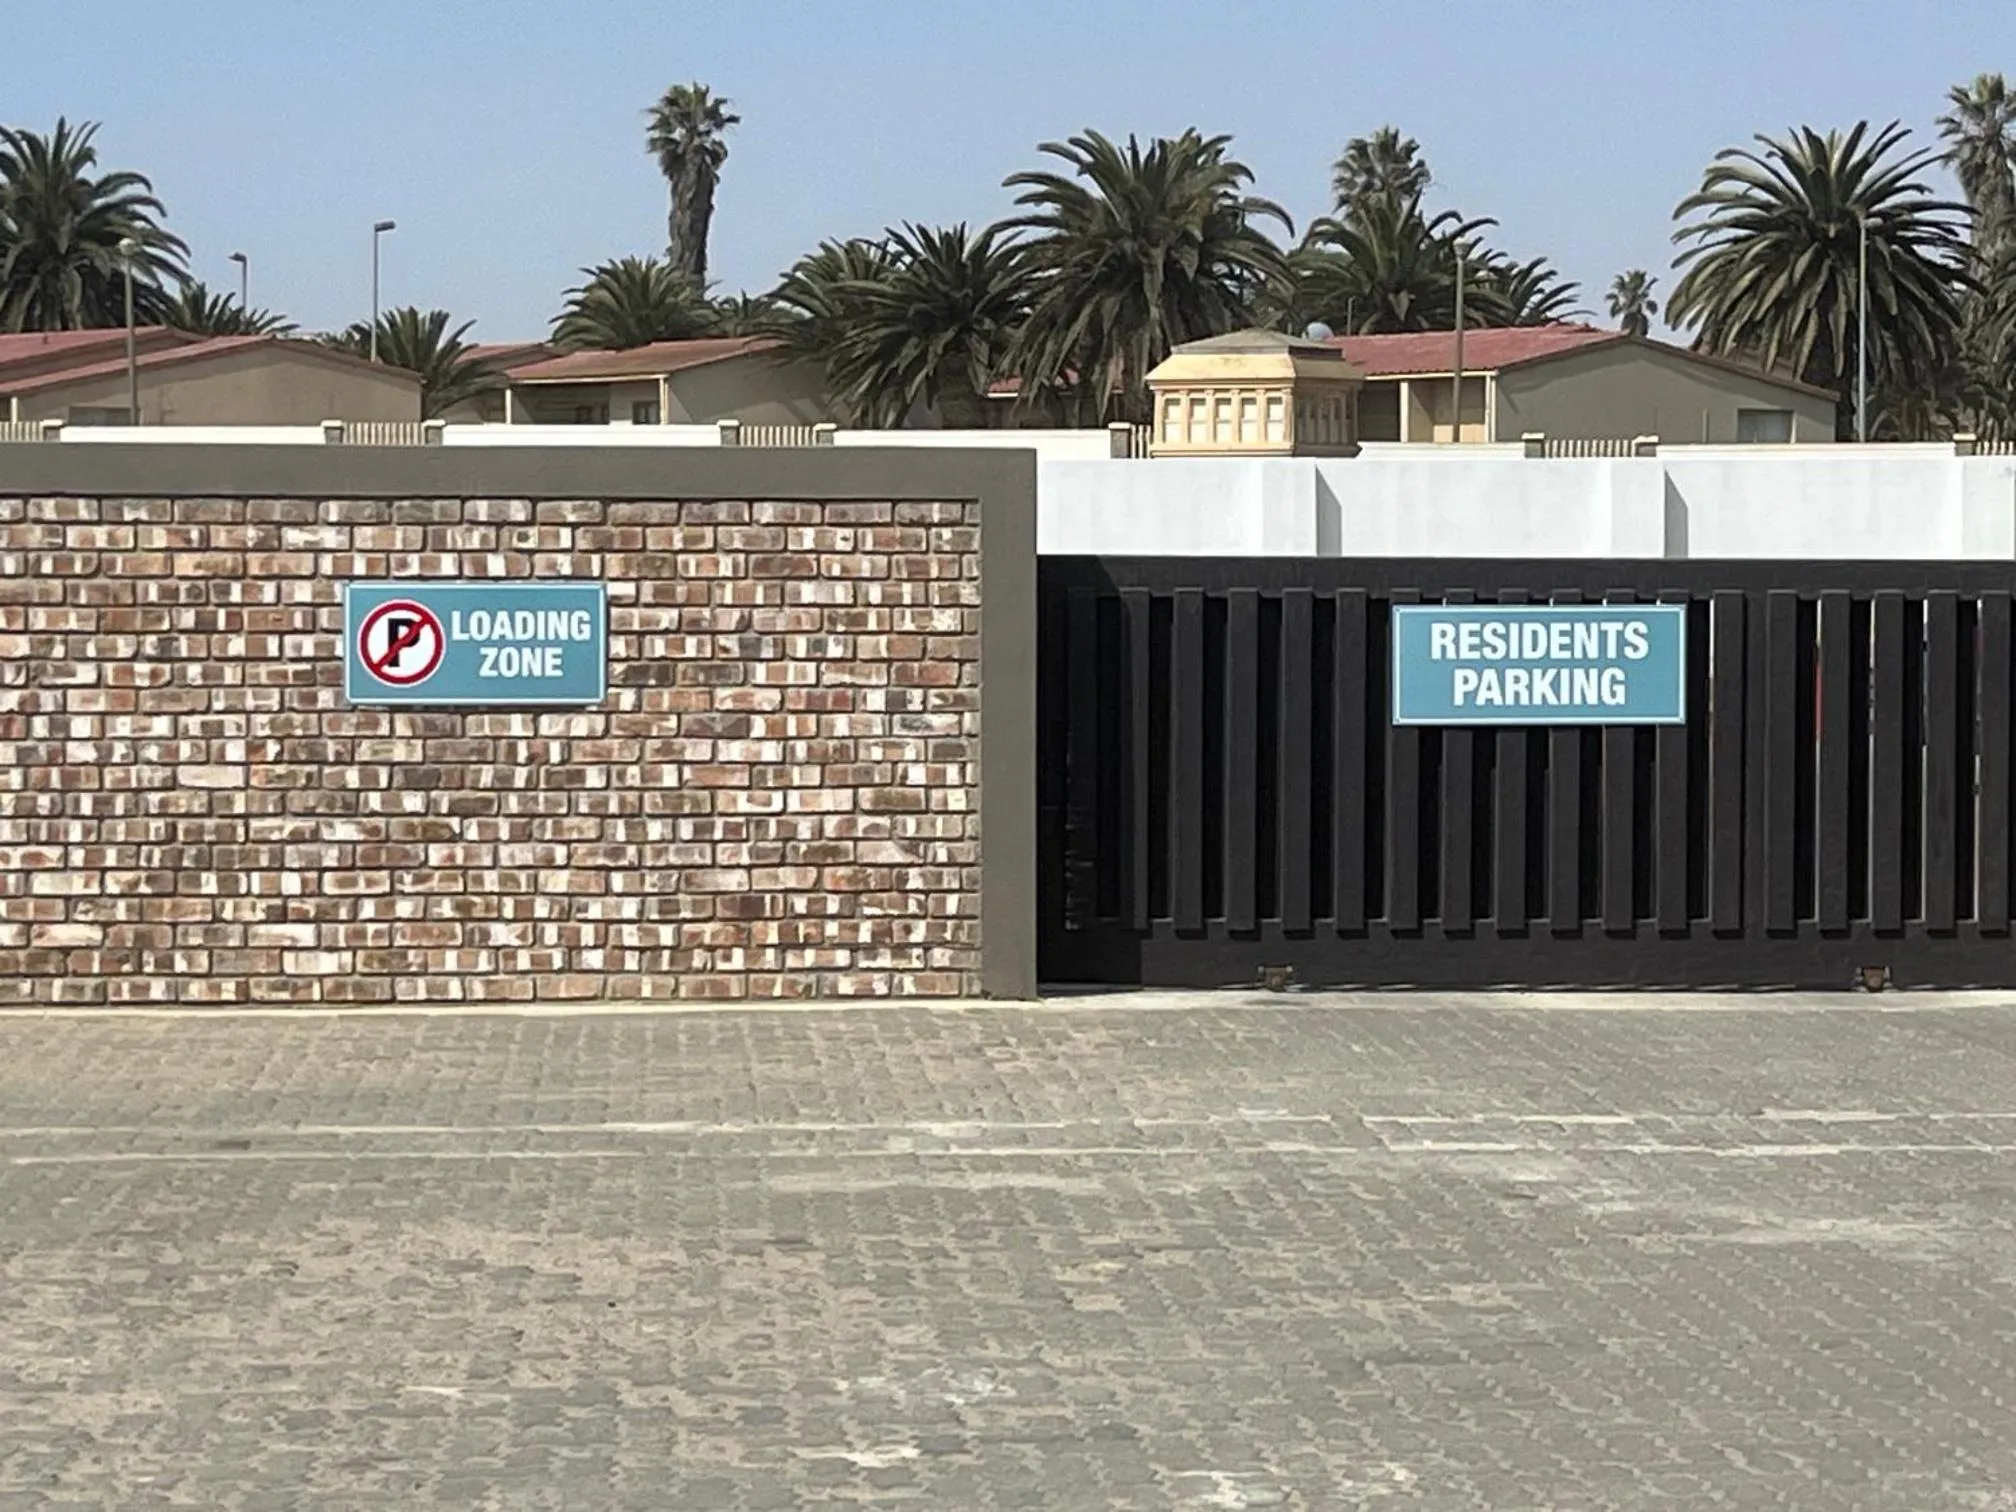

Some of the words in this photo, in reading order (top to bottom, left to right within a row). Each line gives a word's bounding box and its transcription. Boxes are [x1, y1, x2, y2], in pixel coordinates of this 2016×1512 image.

[388, 618, 420, 667] P
[452, 610, 591, 641] LOADING
[1431, 621, 1649, 659] RESIDENTS
[479, 646, 563, 676] ZONE
[1453, 667, 1626, 706] PARKING
